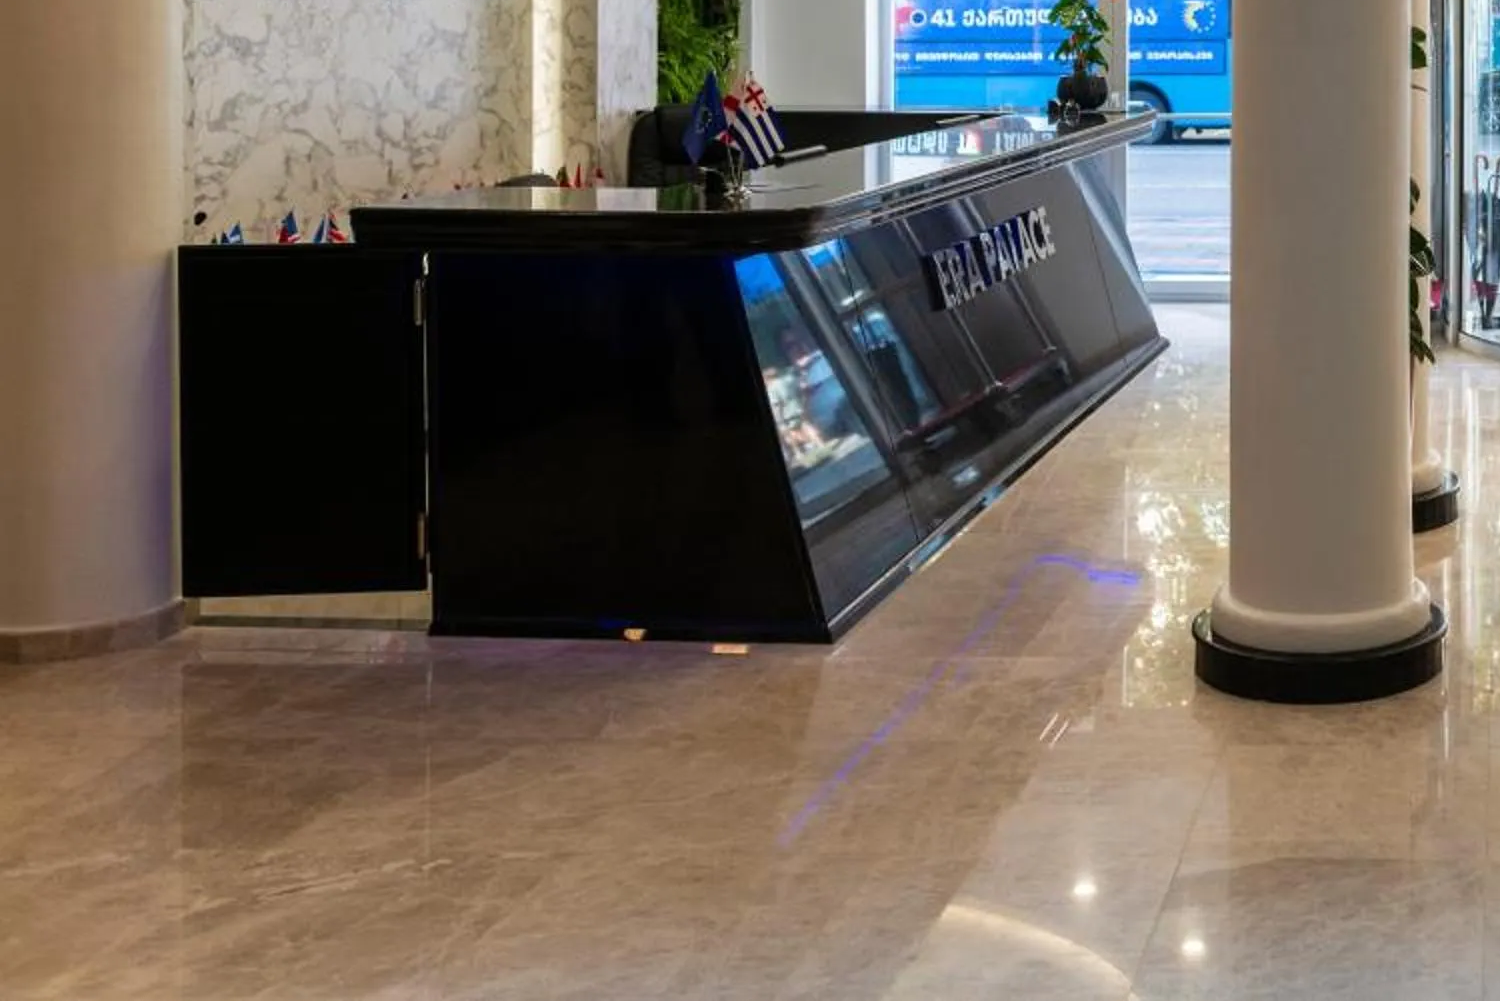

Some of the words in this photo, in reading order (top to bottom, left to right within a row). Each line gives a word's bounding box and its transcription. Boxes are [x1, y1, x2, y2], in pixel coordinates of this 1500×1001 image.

[930, 9, 956, 27] 41
[962, 8, 1057, 27] ქართულ
[932, 240, 988, 309] ERA
[979, 205, 1057, 284] PALACE
